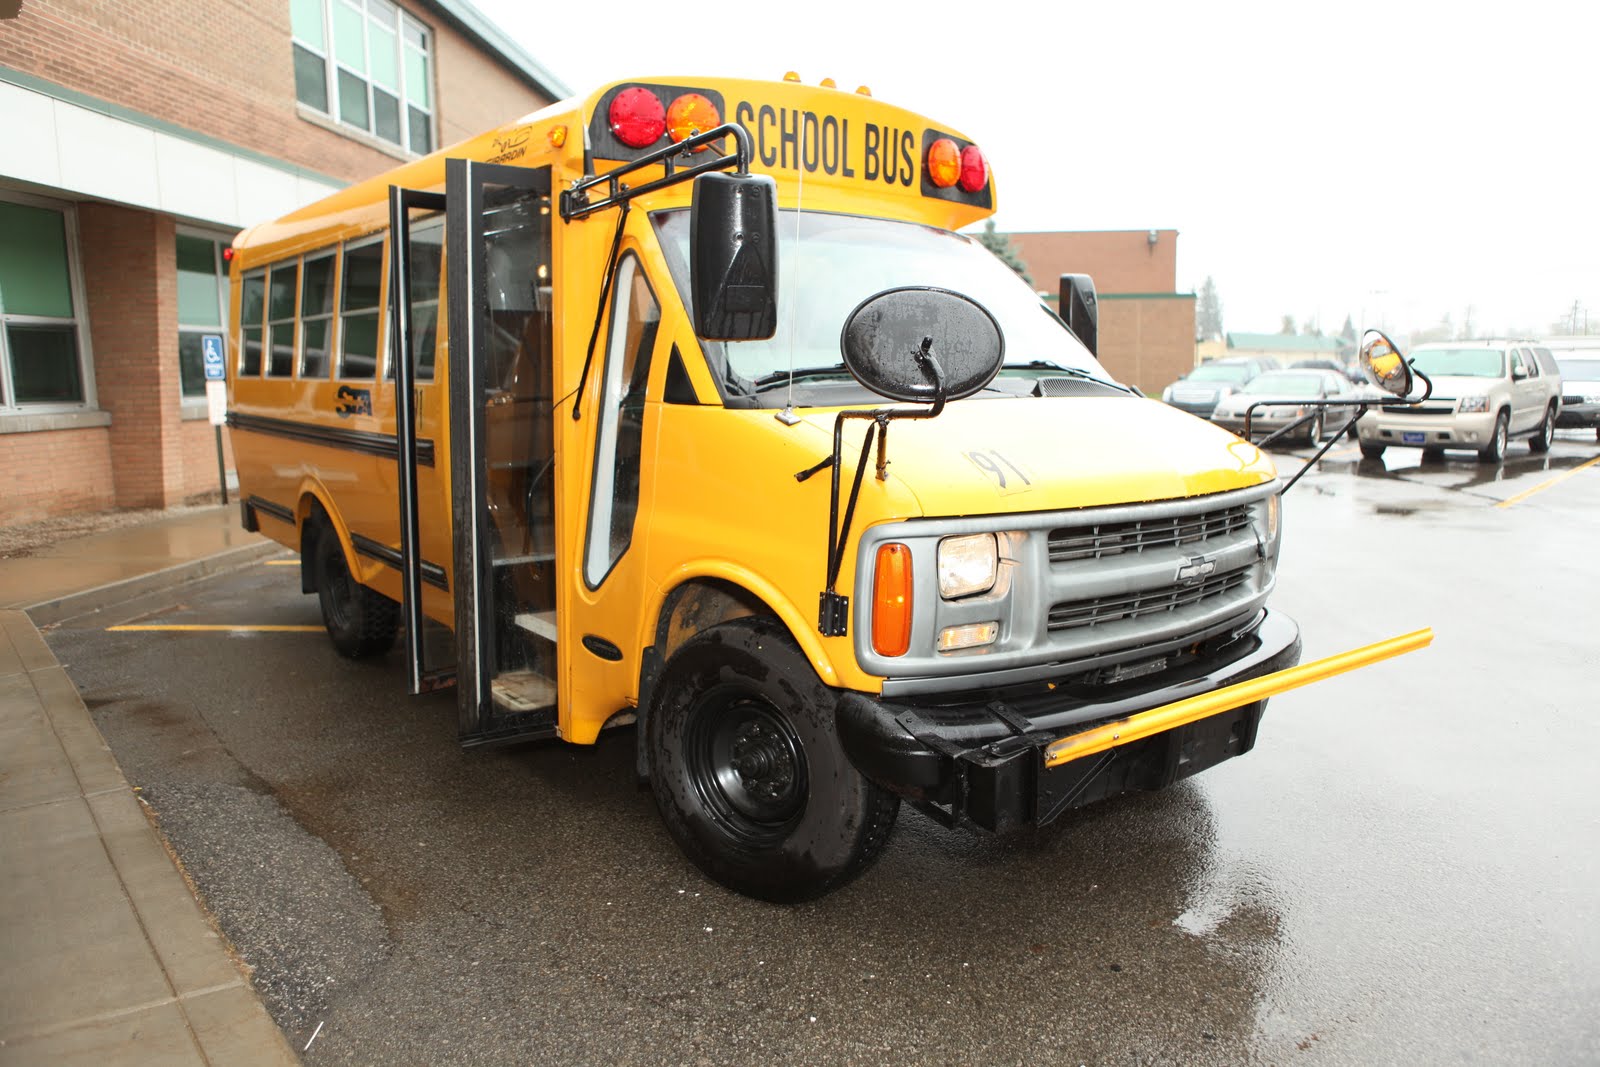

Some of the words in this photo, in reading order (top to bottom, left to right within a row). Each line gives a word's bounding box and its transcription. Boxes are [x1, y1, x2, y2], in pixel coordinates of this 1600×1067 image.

[736, 101, 854, 178] SCHOOL
[865, 123, 914, 187] BUS
[968, 449, 1031, 489] 91
